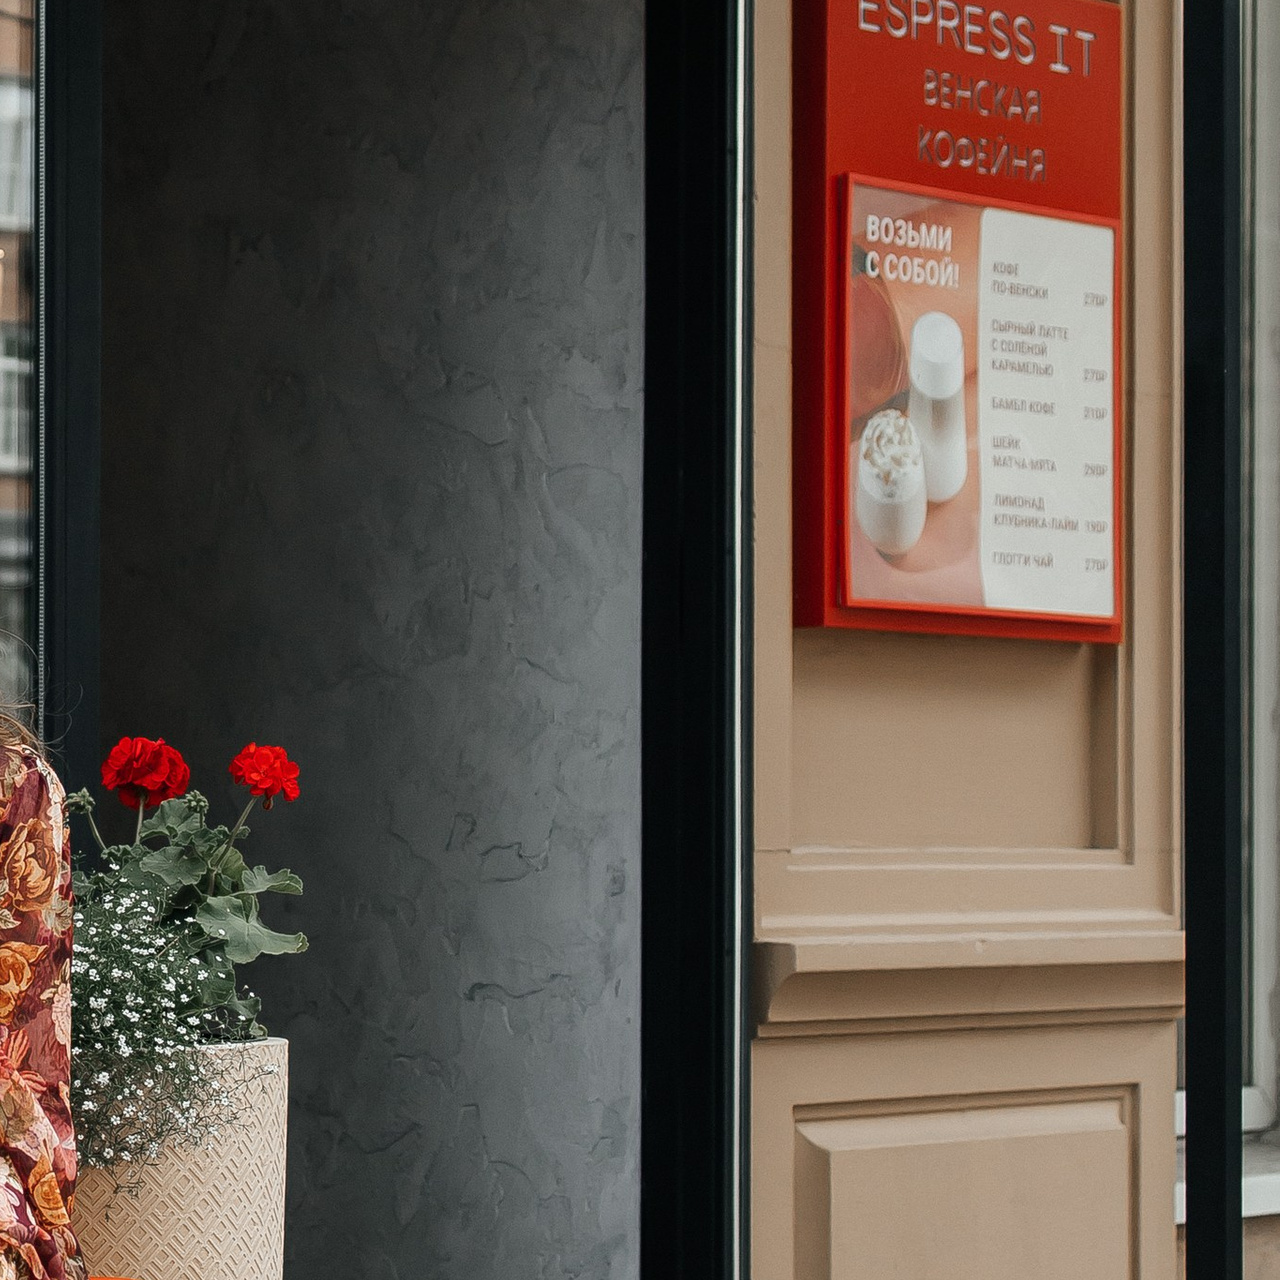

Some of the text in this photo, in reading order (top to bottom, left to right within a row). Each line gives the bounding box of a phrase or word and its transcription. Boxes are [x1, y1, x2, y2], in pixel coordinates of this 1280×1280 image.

[1047, 23, 1097, 76] IT
[923, 68, 1042, 124] ВЕНСКАЯ
[917, 124, 1046, 182] КОФЕЙНЯ
[865, 214, 952, 253] ВОЗЬМИ
[865, 250, 960, 288] С СОБОЙ!
[993, 262, 1019, 277] КОФЕ
